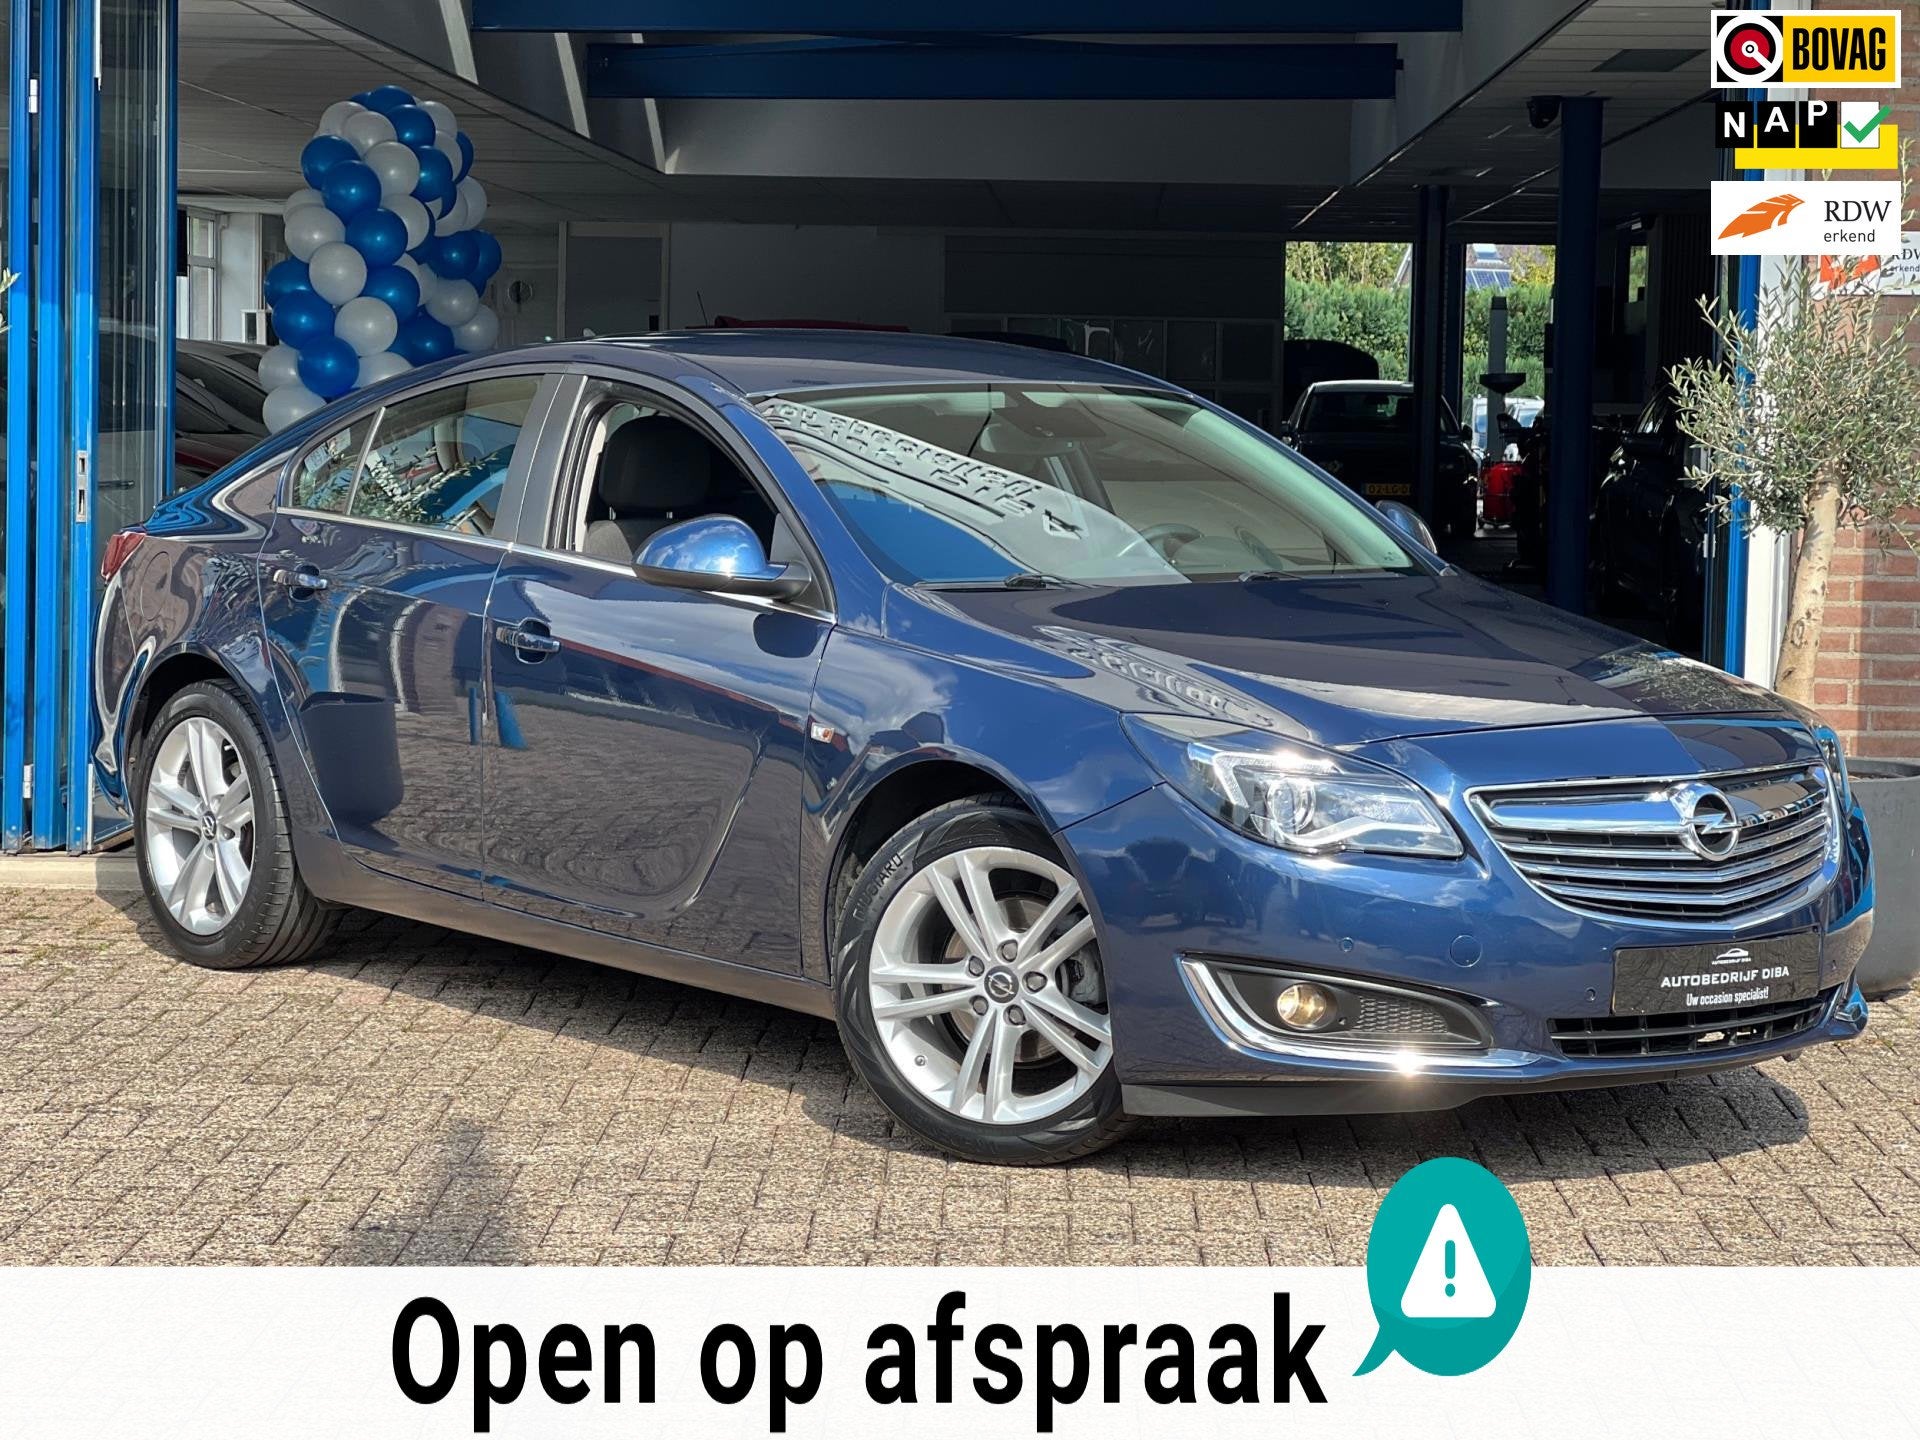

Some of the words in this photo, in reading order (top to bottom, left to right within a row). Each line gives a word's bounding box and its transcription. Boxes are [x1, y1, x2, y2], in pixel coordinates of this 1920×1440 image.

[1660, 969, 1759, 988] AUTOBEDRIJF
[1761, 965, 1790, 980] DIBA
[1686, 992, 1699, 1006] Uw
[1700, 992, 1733, 1005] occasion
[1734, 986, 1769, 1004] specialist!
